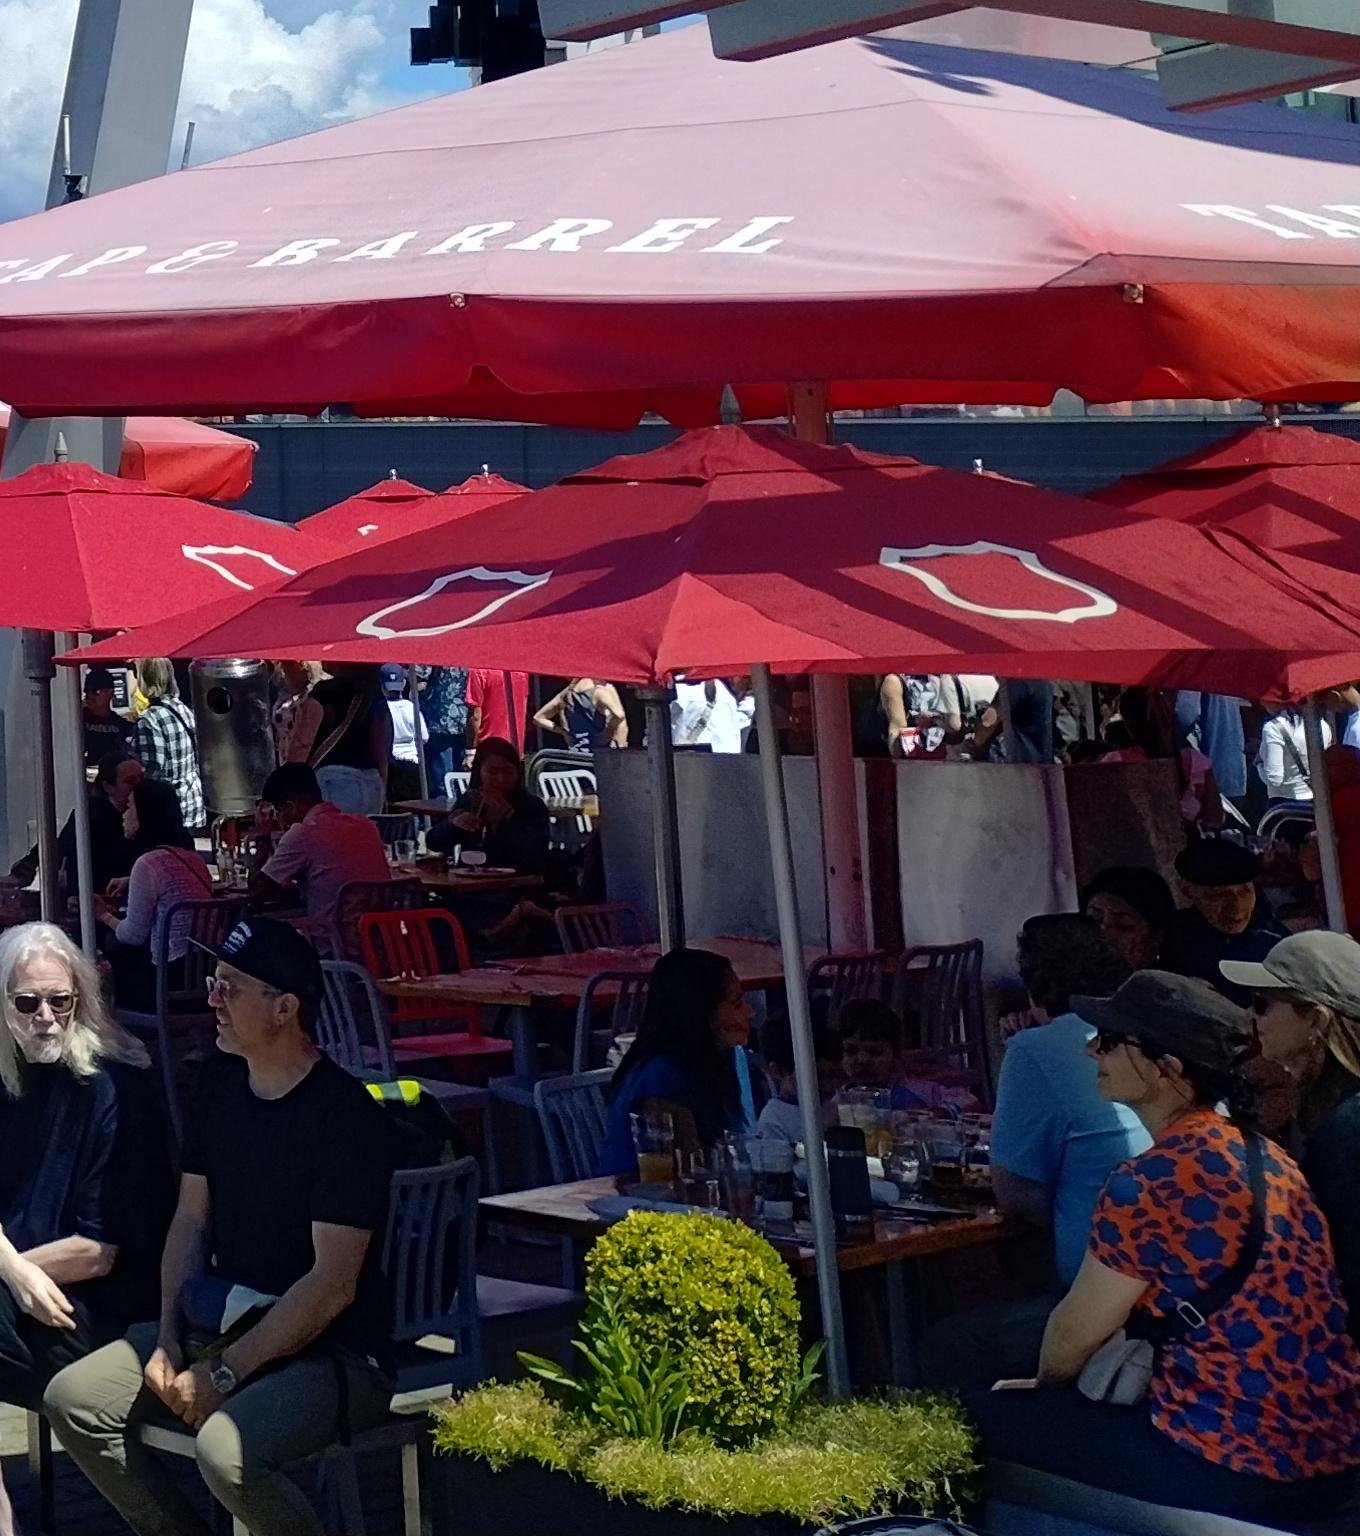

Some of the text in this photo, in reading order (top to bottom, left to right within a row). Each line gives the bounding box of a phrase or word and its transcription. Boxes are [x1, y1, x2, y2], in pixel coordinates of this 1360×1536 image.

[1179, 204, 1360, 239] TA
[145, 239, 239, 274] &
[247, 216, 794, 268] BARREL
